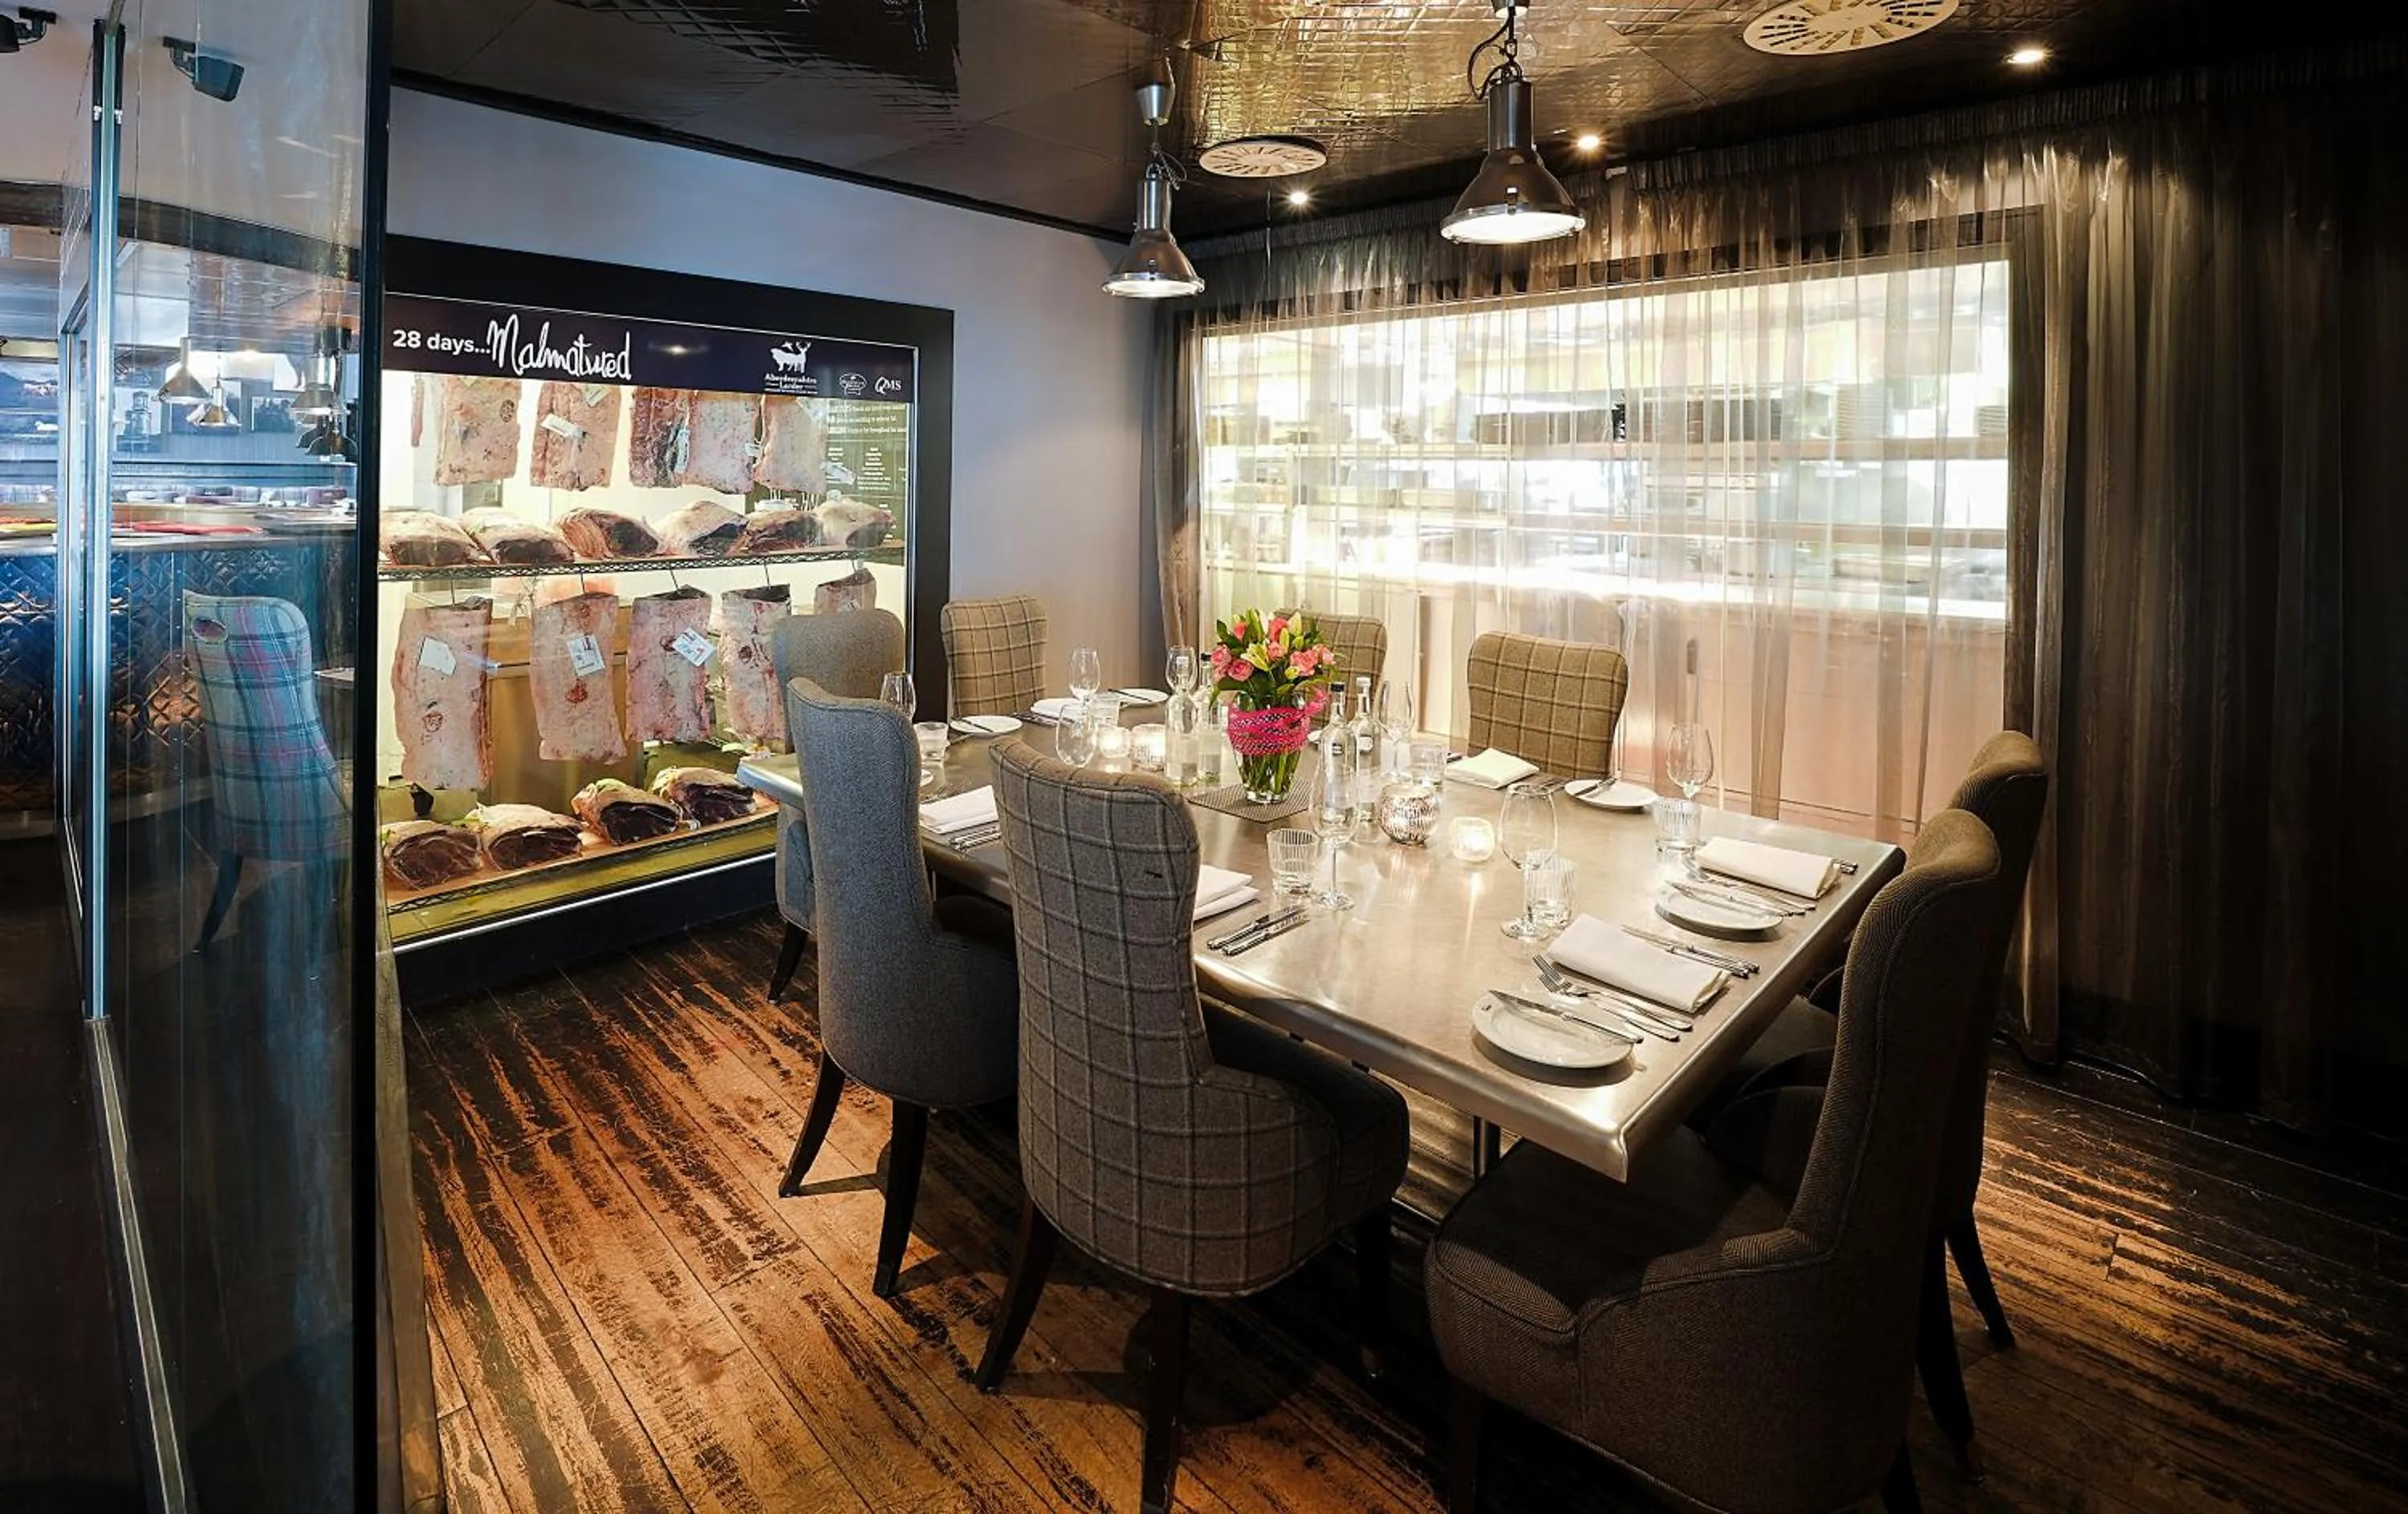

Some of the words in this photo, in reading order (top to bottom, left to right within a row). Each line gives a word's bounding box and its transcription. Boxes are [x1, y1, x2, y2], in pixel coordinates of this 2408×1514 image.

[393, 329, 421, 348] 28
[426, 332, 490, 356] days...
[486, 314, 632, 381] Malmatured
[874, 376, 901, 395] QMS
